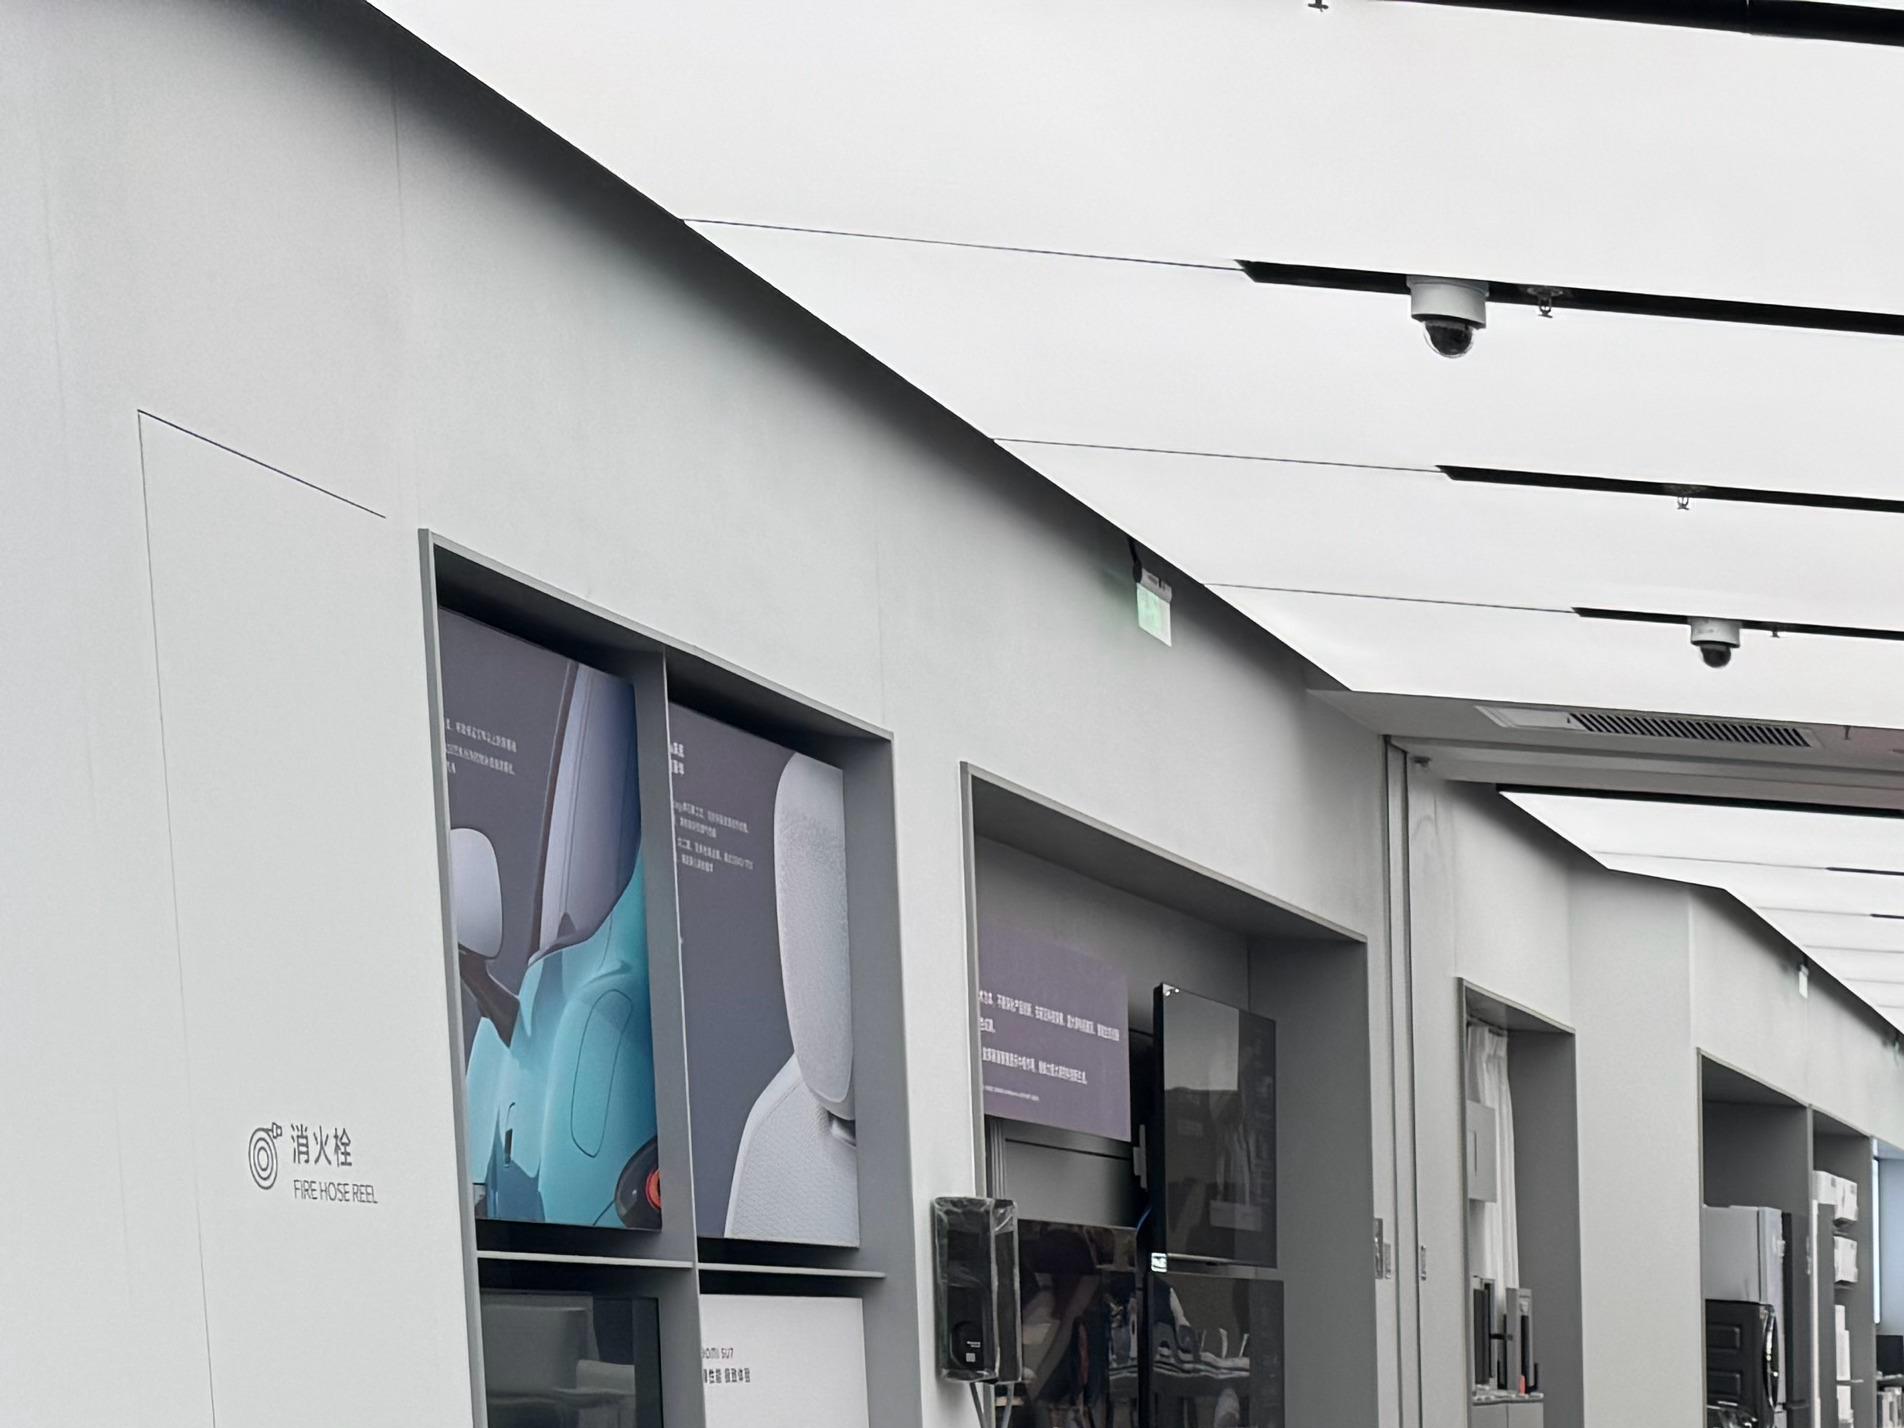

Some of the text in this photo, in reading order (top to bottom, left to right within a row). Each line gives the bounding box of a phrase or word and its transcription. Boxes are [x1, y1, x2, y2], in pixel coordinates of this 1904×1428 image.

[290, 1123, 352, 1167] 消火栓
[293, 1179, 379, 1204] FIRE HOSE REEL
